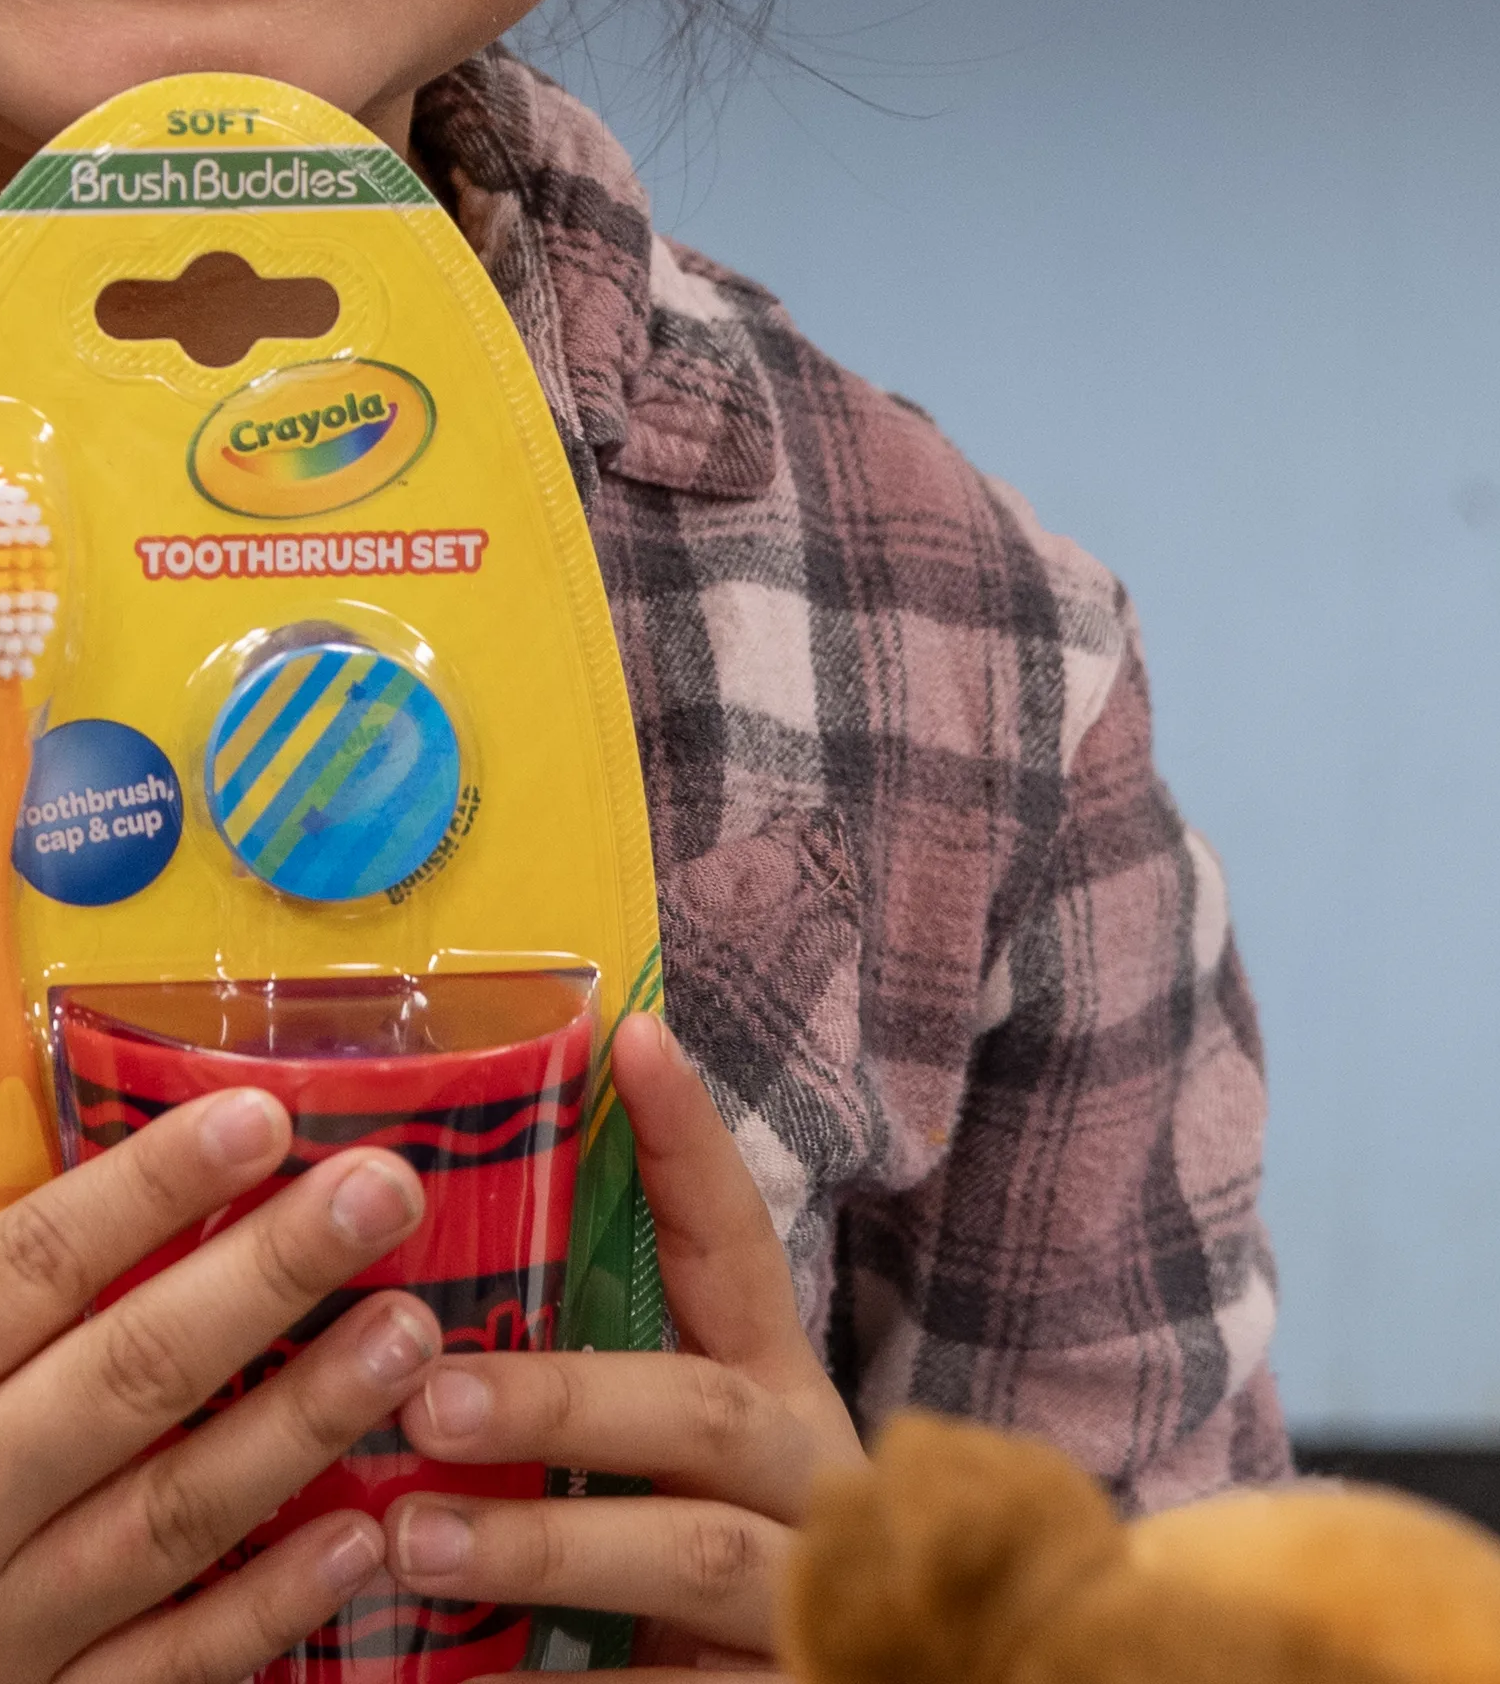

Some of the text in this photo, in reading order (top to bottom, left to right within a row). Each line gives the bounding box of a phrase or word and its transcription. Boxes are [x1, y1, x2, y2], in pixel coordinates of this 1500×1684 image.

[167, 108, 259, 136] SOFT
[229, 392, 386, 453] Crayola
[140, 534, 482, 575] TOOTHBRUSH SET
[35, 809, 163, 855] cap & cup
